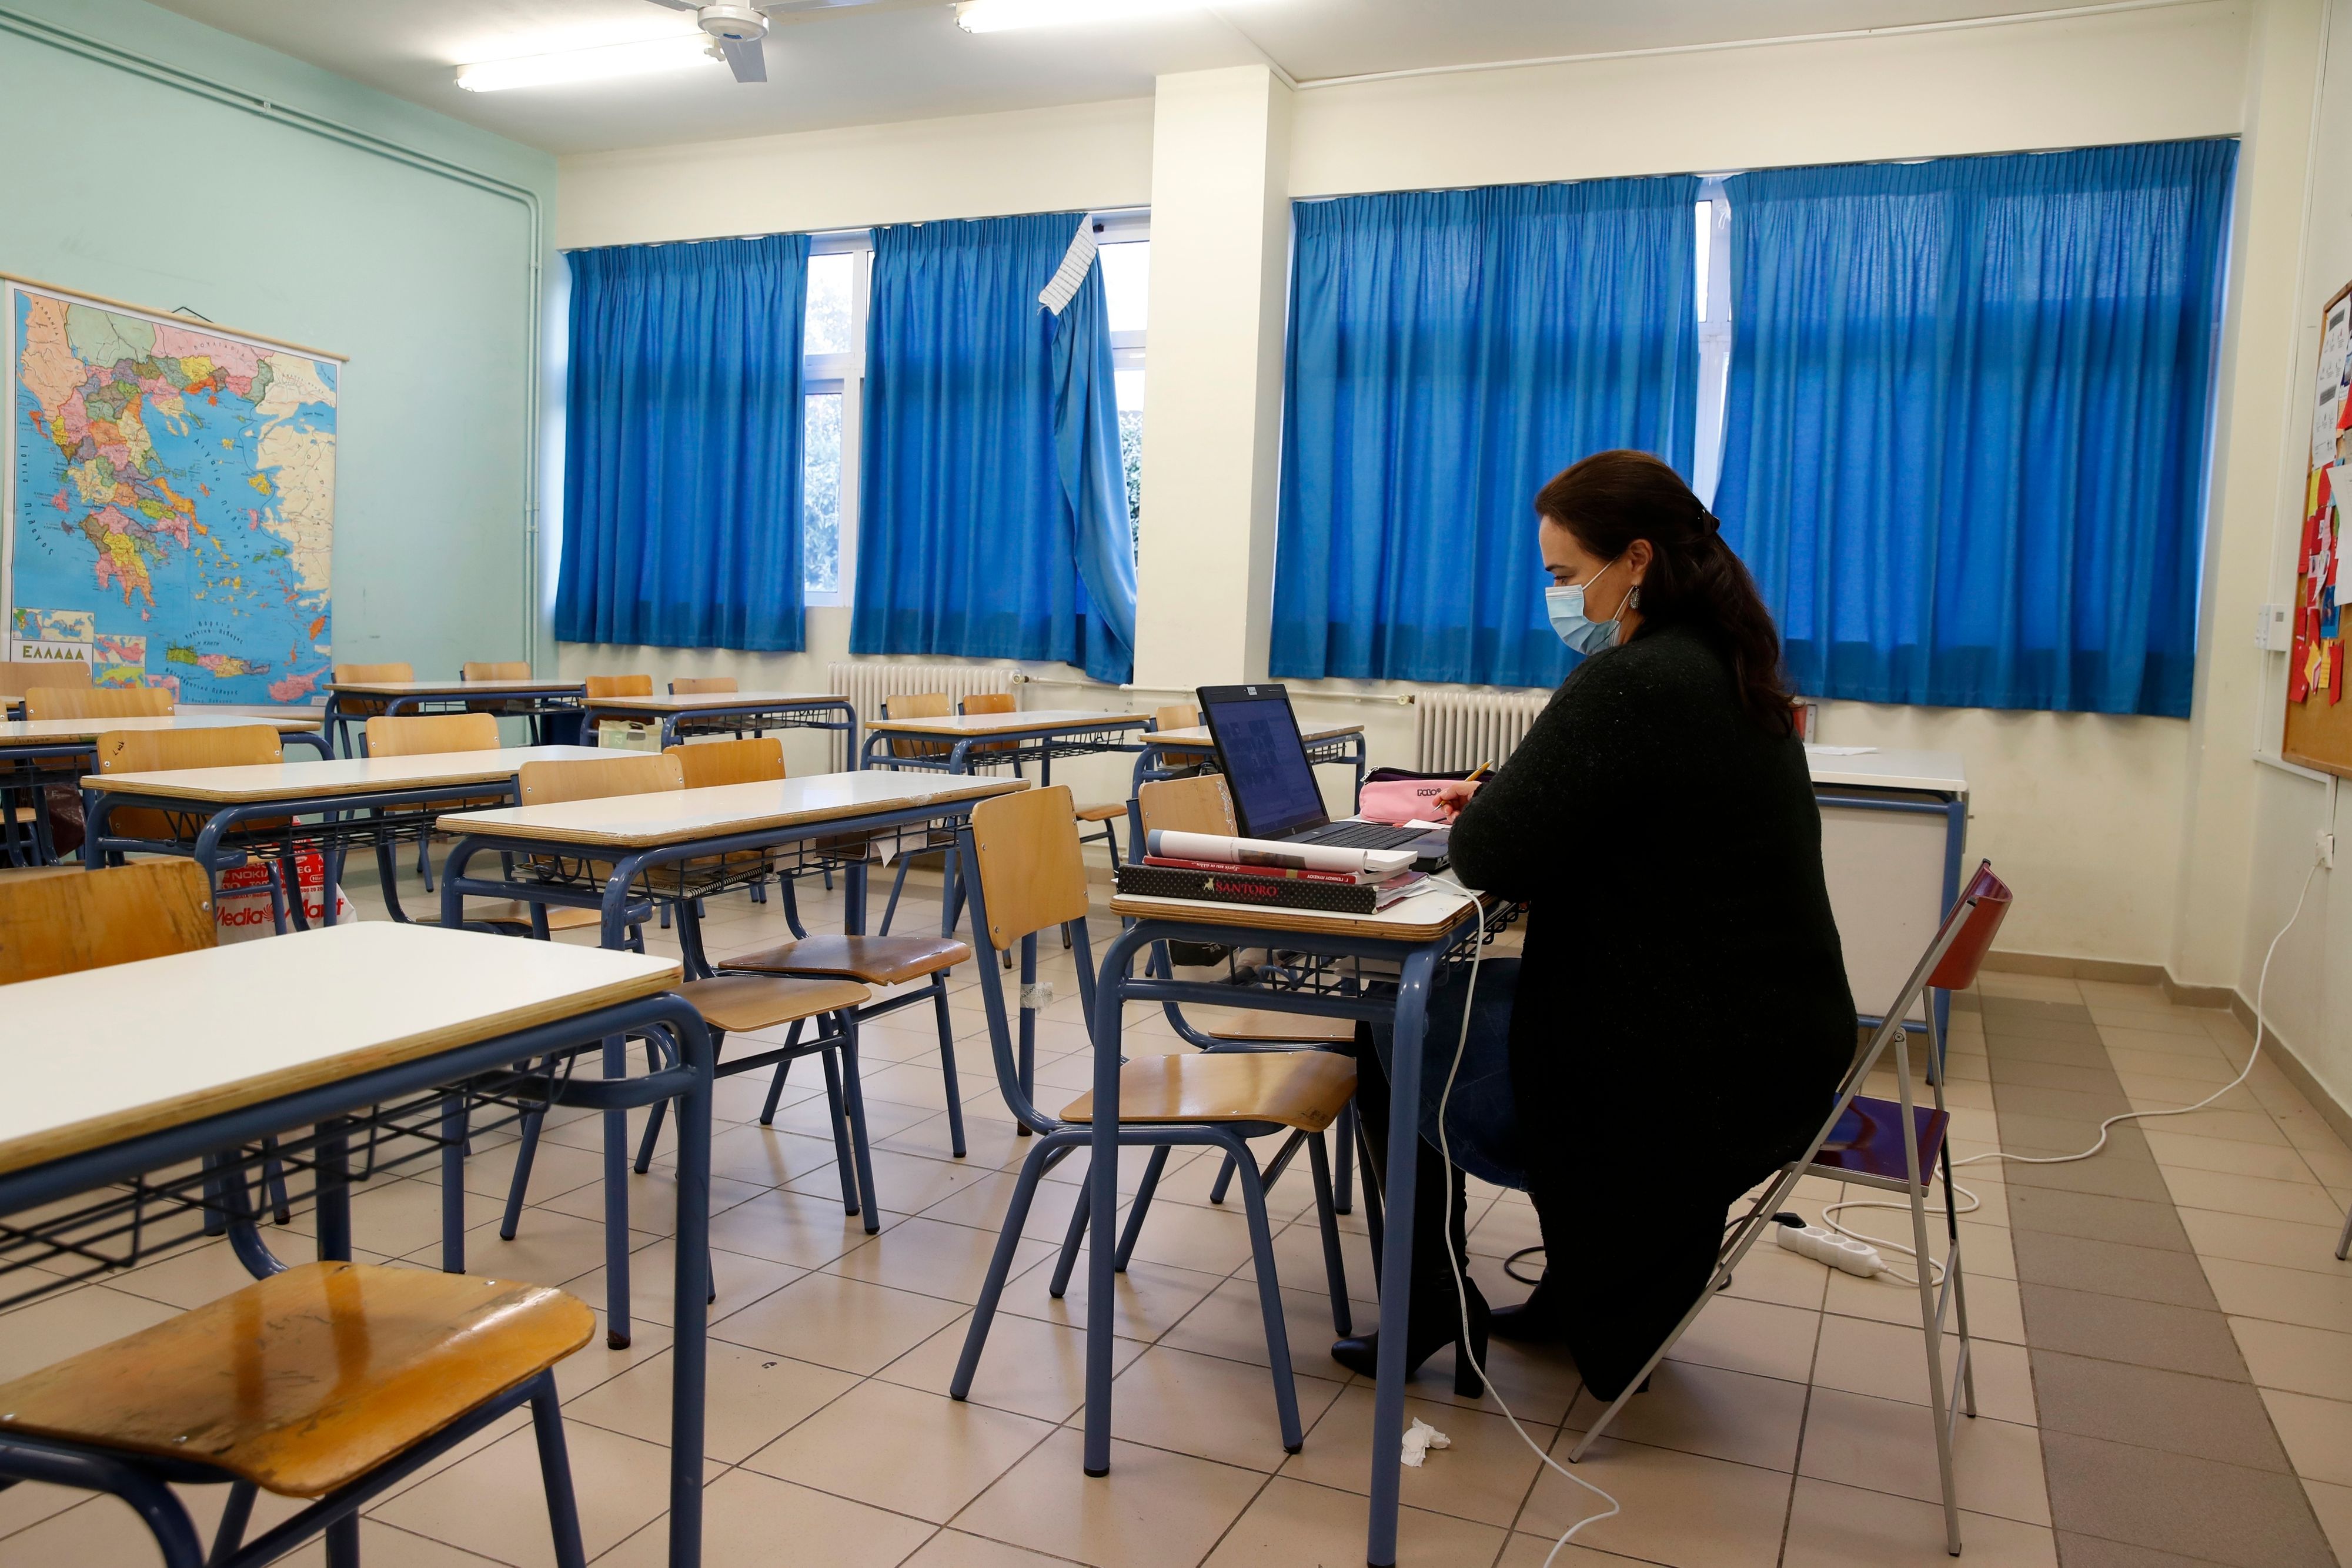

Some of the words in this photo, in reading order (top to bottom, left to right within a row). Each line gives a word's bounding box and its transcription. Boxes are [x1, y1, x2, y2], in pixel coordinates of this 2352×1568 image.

[23, 645, 84, 660] ΕΛΛΑΔΑ
[1215, 881, 1278, 896] SANTORO
[285, 898, 344, 920] Mat
